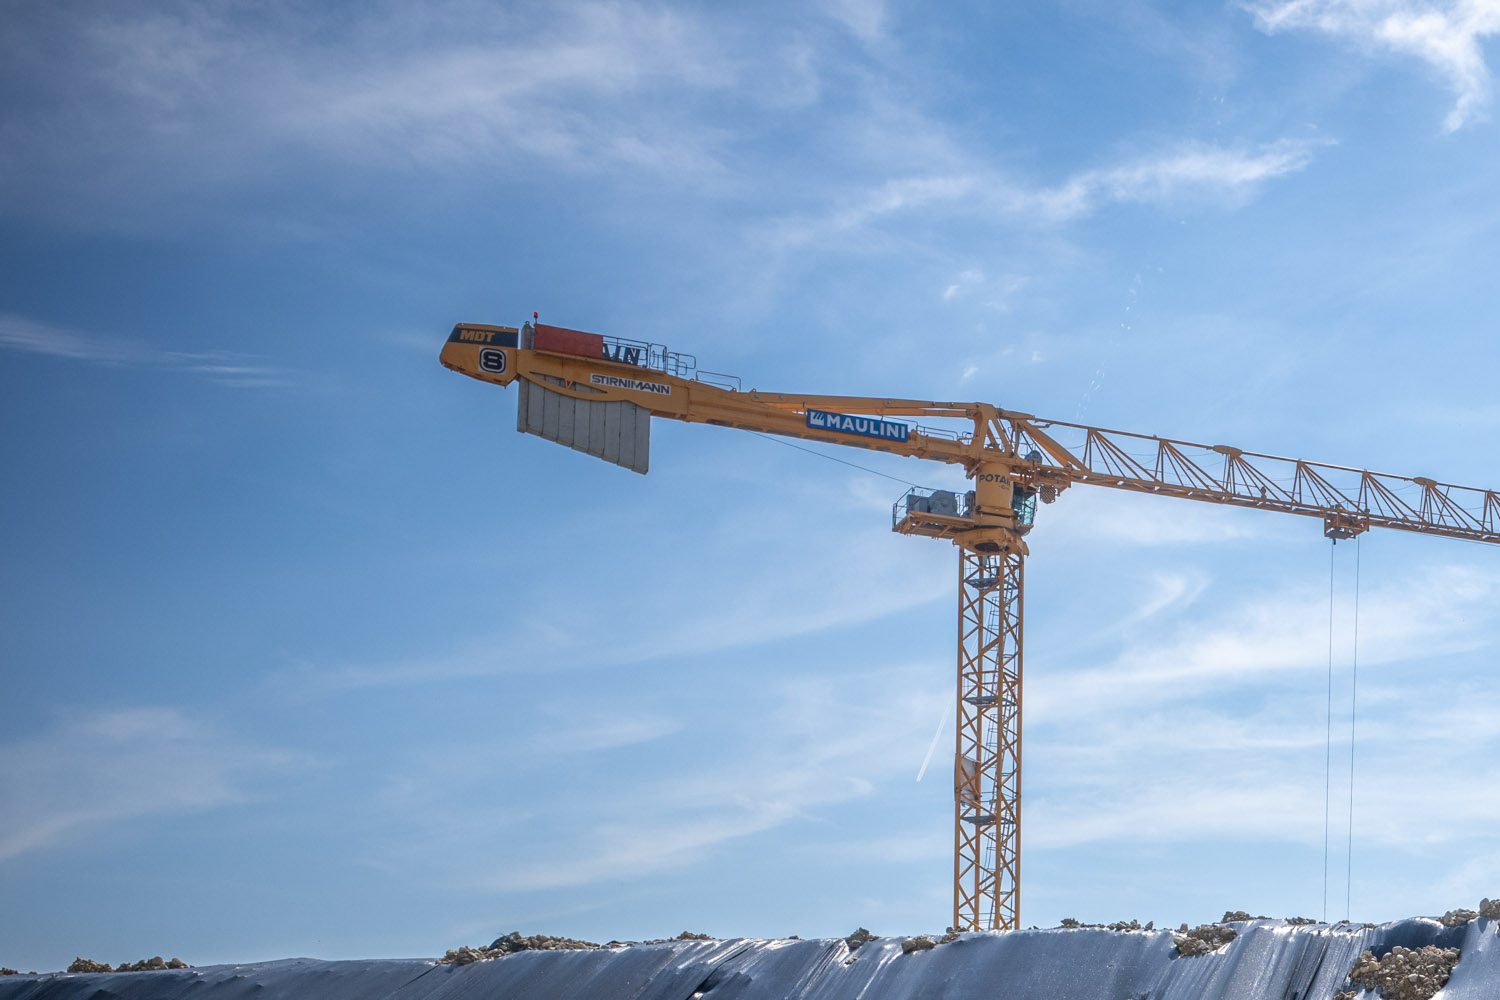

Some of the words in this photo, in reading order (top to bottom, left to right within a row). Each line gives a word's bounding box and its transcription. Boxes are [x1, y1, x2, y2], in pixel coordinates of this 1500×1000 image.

[460, 329, 496, 343] MDT
[591, 374, 670, 395] STIRNIMANN
[827, 414, 905, 439] MAULINI
